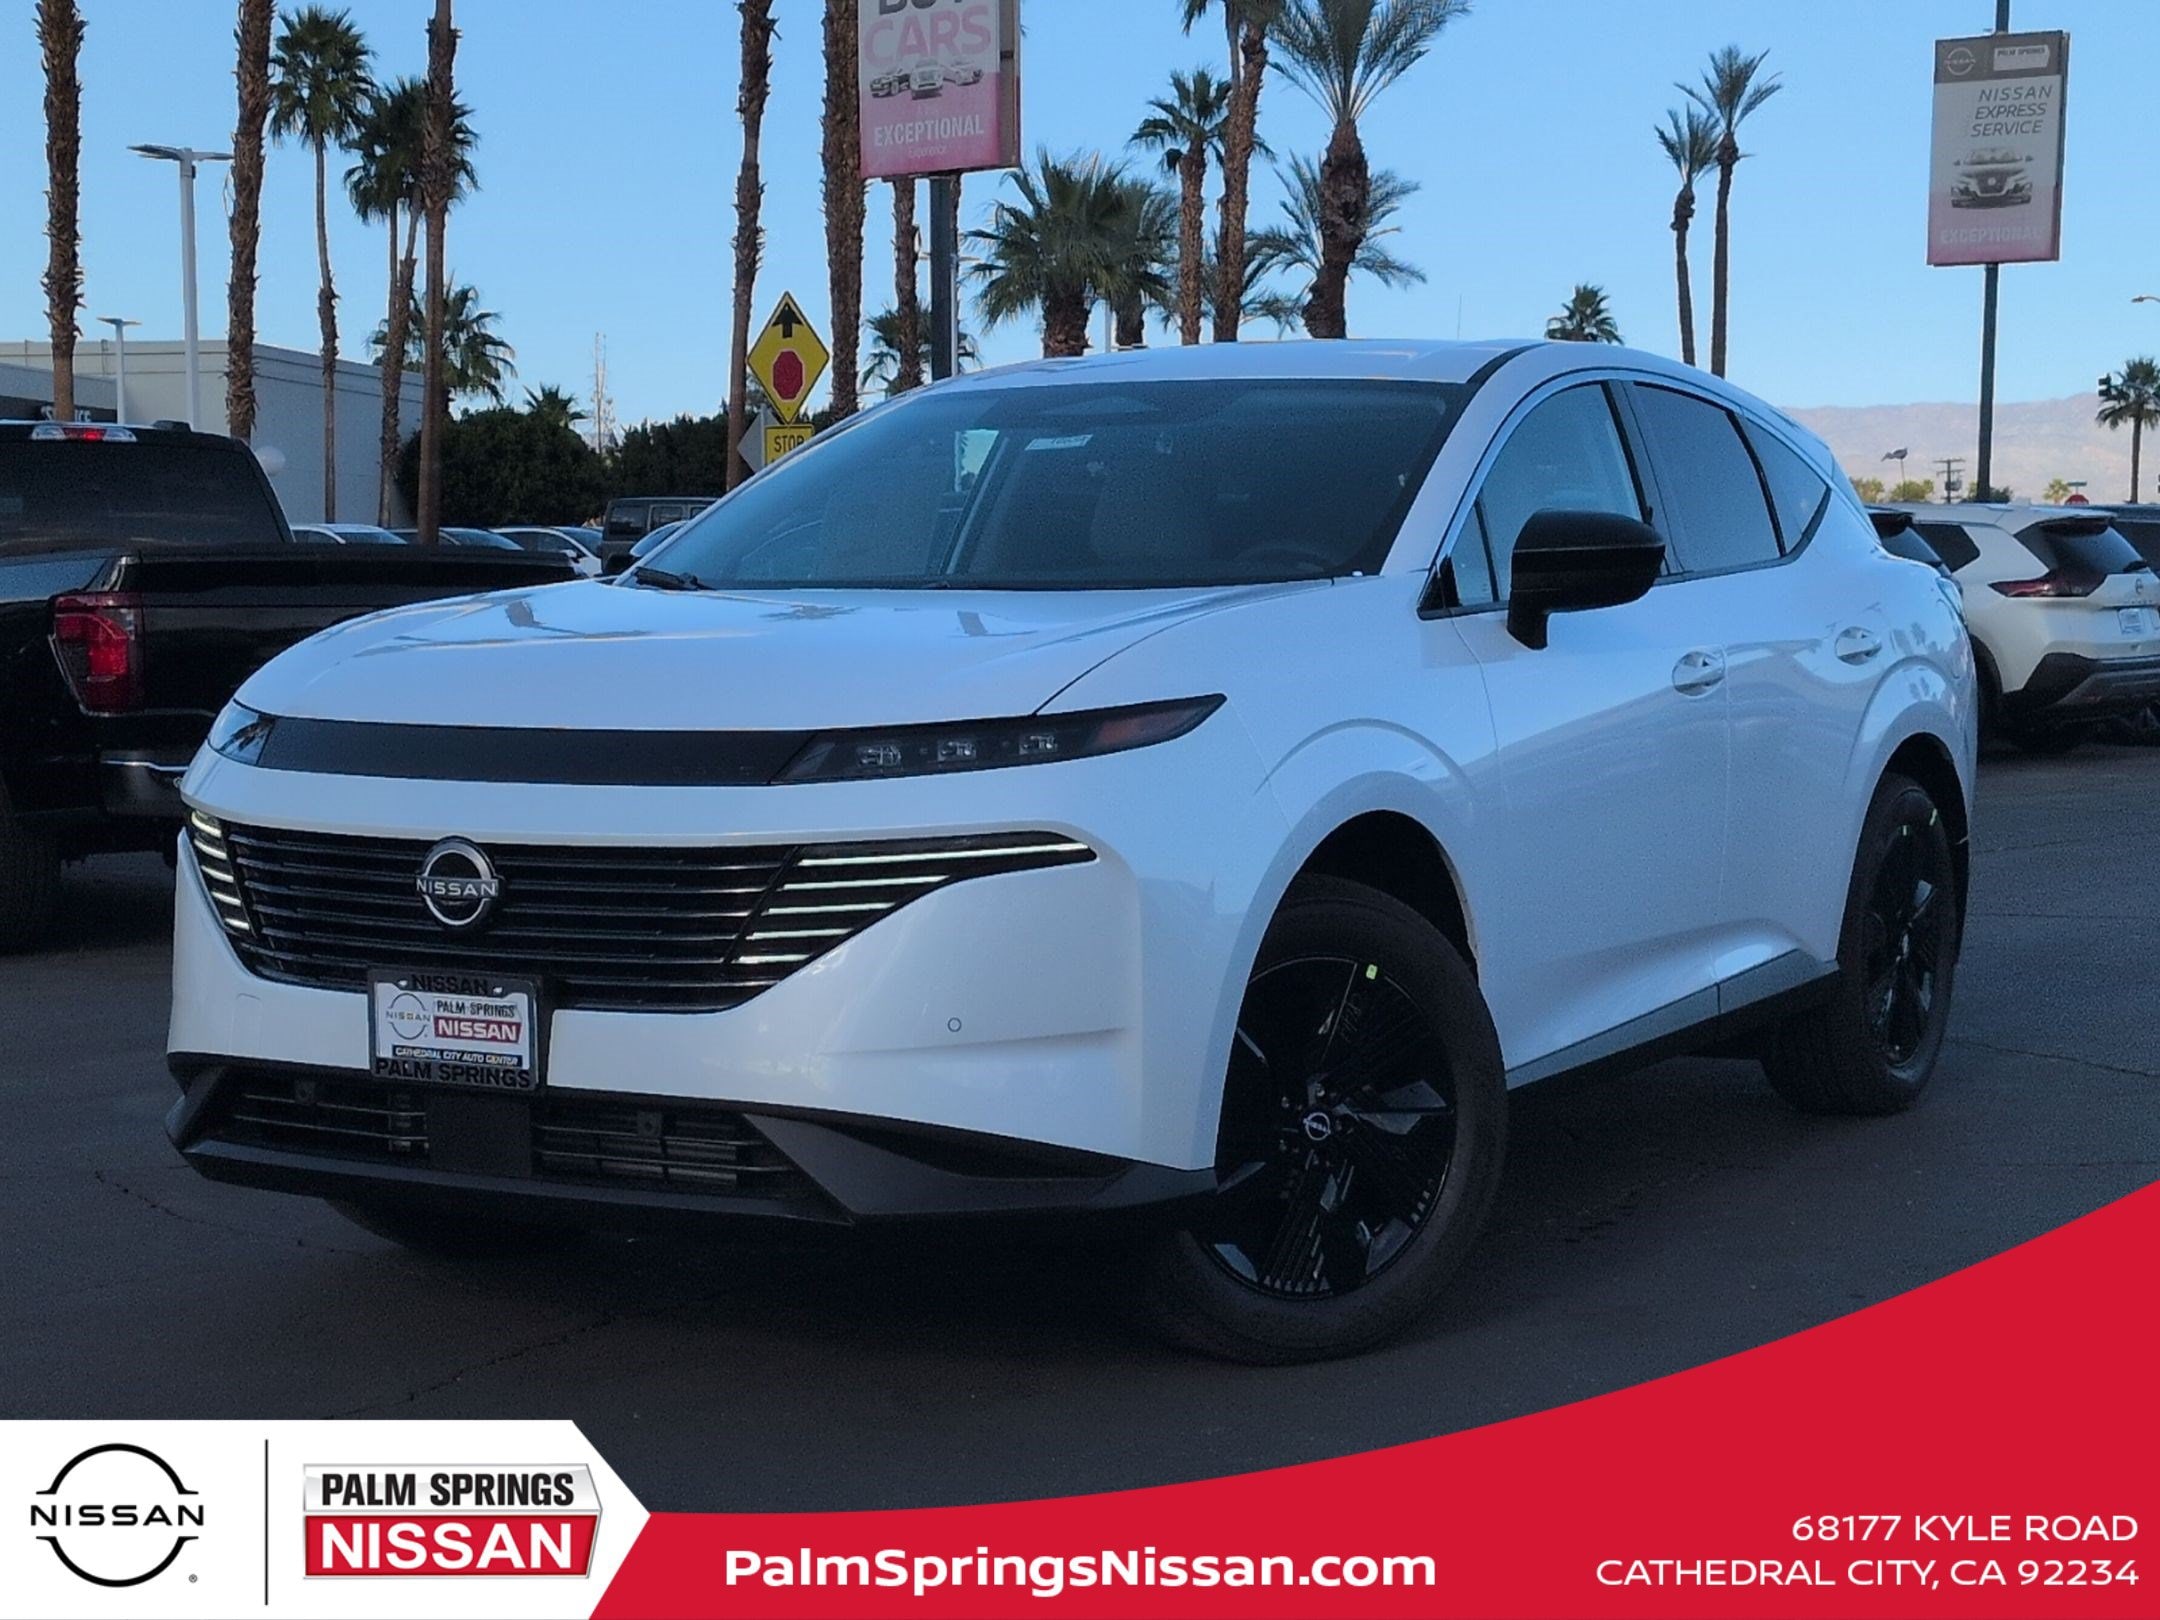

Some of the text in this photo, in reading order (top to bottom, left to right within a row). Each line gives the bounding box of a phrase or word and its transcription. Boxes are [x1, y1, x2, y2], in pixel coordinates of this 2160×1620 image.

[865, 4, 991, 68] CARS
[1979, 84, 2053, 102] NISSAN
[1975, 103, 2047, 120] EXPRESS
[874, 114, 985, 148] EXCEPTIONAL
[1971, 119, 2044, 138] SERVICE
[774, 434, 804, 453] STOP
[416, 878, 496, 897] NISSAN
[411, 973, 489, 996] NISSAN
[385, 1010, 431, 1022] NISSAN
[436, 999, 515, 1018] PALM SPRINGS
[437, 1019, 518, 1042] NISSAN
[442, 1050, 461, 1060] CITY
[462, 1052, 484, 1063] AUTO
[375, 1058, 531, 1089] PALM SPRINGS
